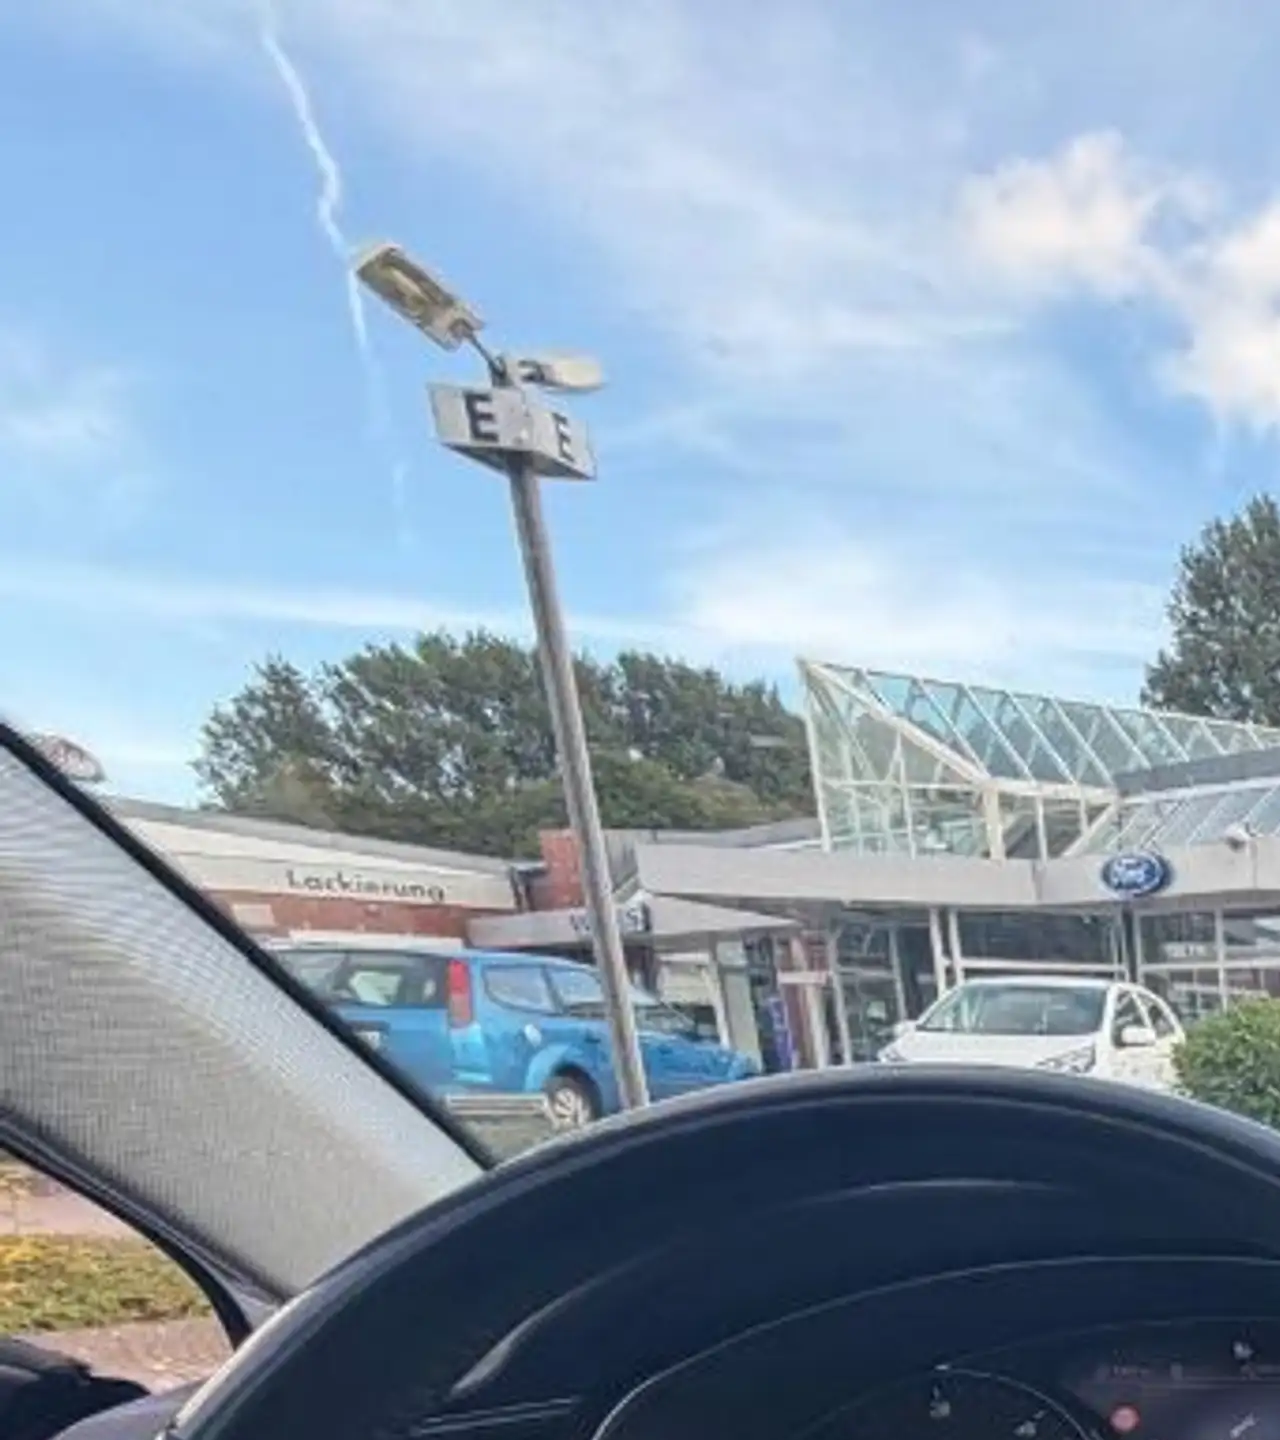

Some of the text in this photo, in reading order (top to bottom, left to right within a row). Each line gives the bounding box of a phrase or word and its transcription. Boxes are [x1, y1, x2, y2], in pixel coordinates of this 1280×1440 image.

[463, 390, 499, 442] E
[552, 412, 575, 463] E
[287, 869, 446, 903] Lackierung
